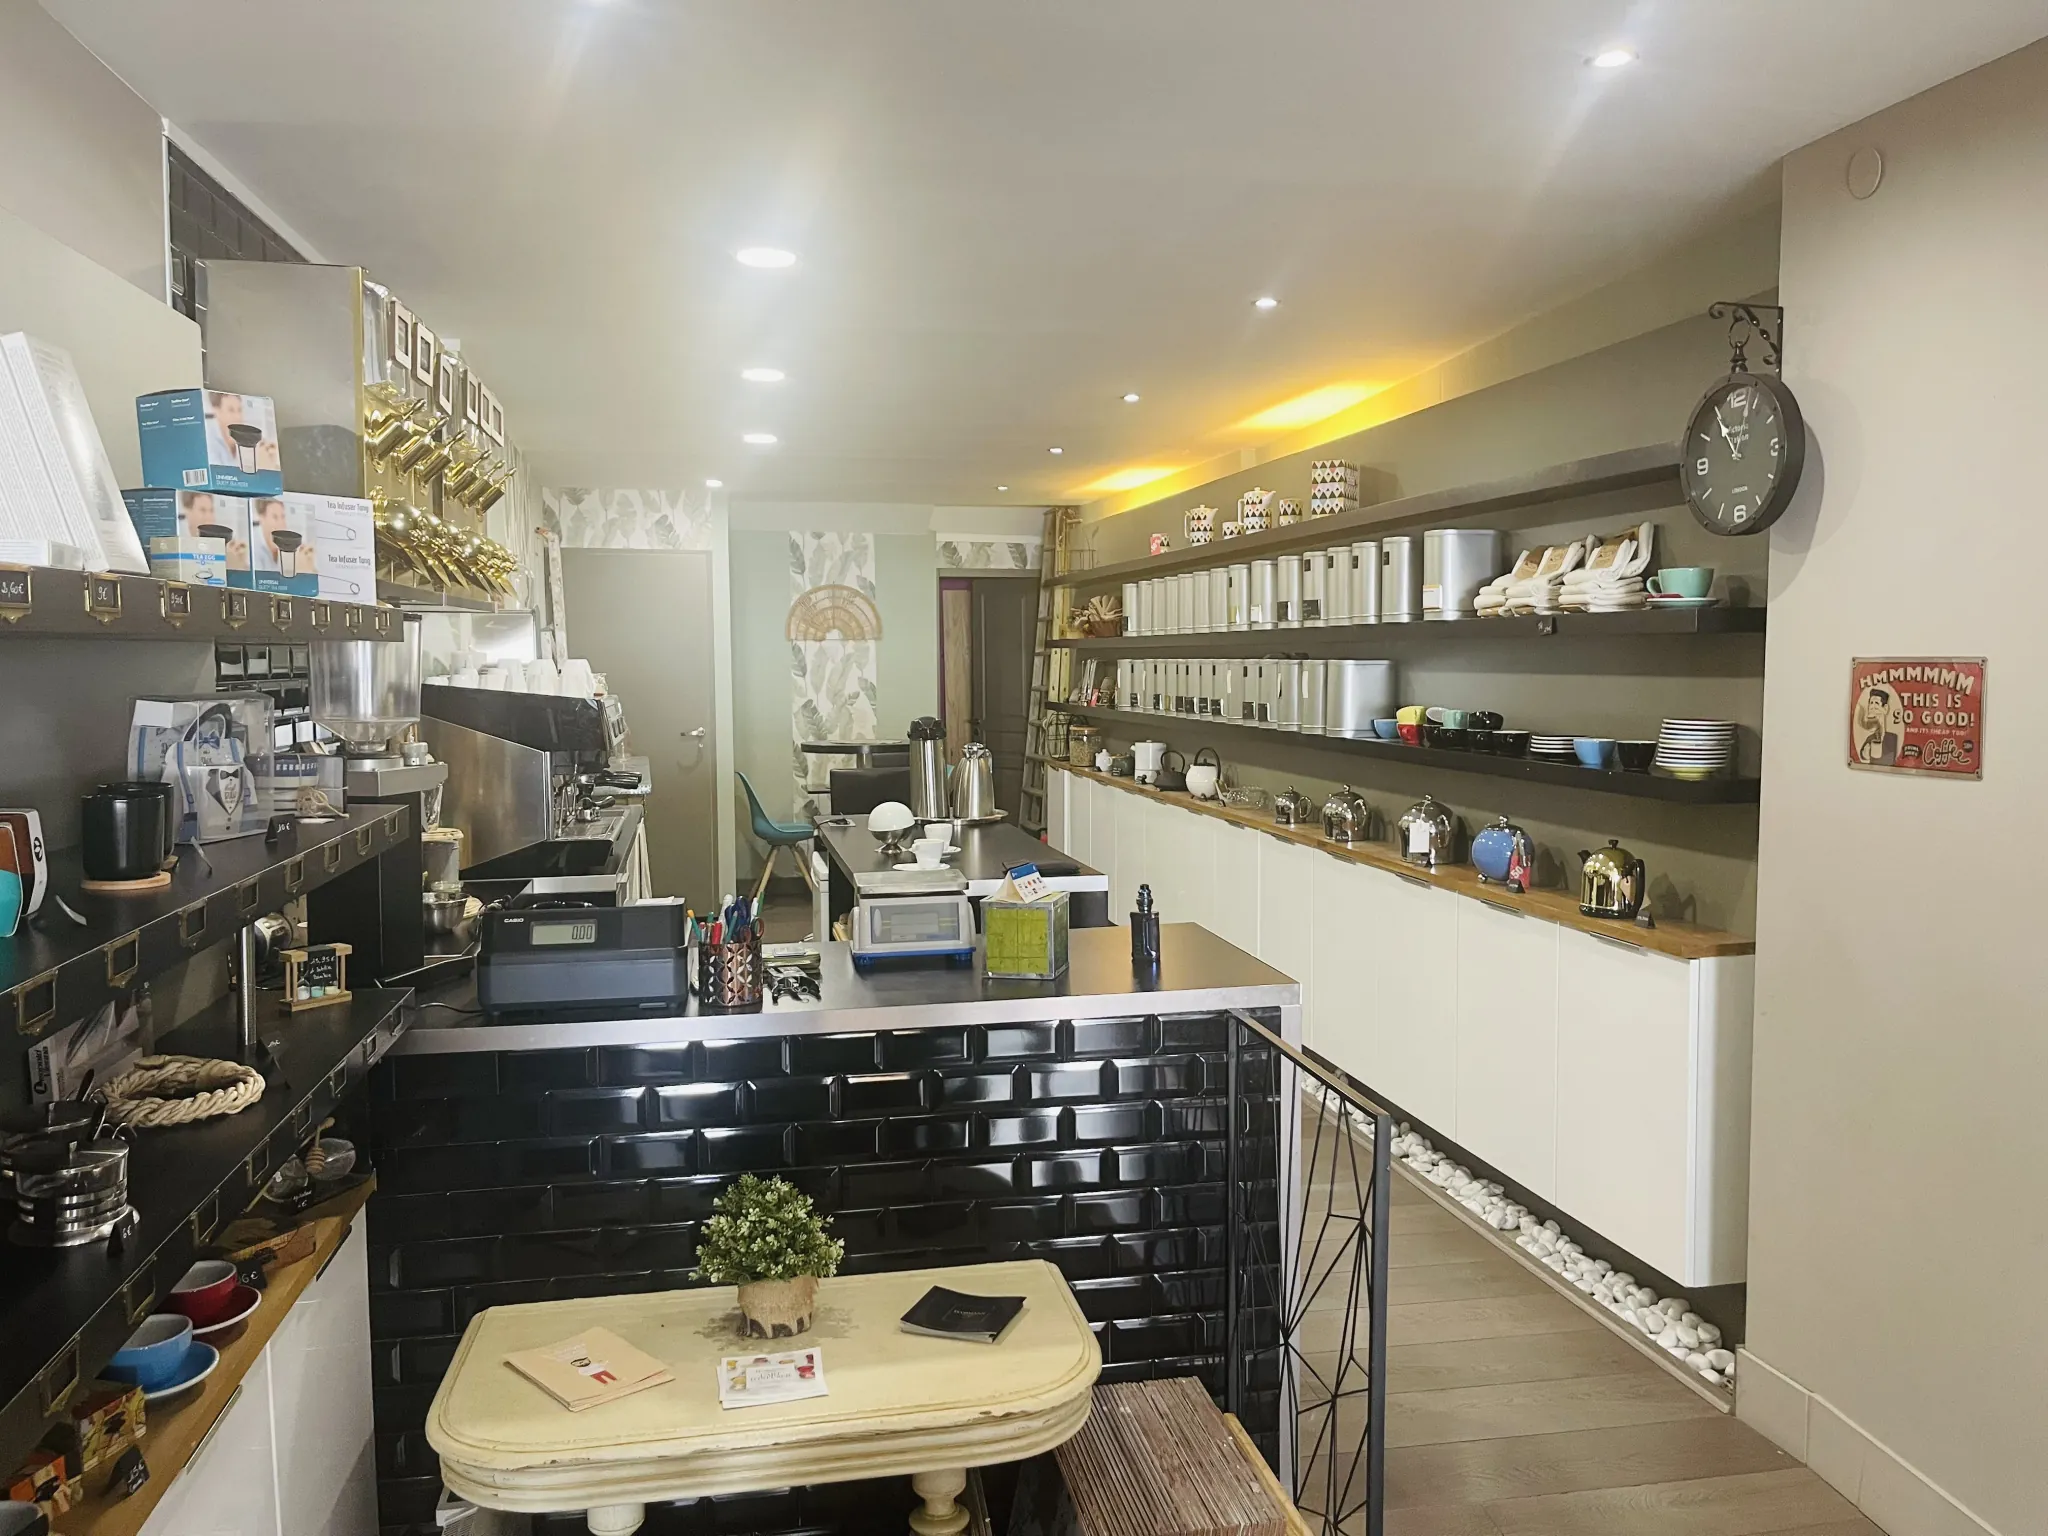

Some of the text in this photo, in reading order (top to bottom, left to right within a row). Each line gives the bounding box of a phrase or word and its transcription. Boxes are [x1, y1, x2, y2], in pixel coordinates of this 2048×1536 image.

[1727, 387, 1747, 408] 12
[1770, 437, 1779, 457] 3
[1696, 457, 1709, 475] 9
[1731, 485, 1748, 495] LONDON
[327, 501, 336, 509] Tea
[337, 501, 356, 511] Infuser
[1733, 504, 1747, 523] 6
[328, 554, 338, 563] Tea
[338, 554, 357, 564] Infuser
[1901, 692, 1962, 709] THIS IS
[1893, 709, 1975, 727] SO GOOD!
[1923, 738, 1971, 766] Coffee
